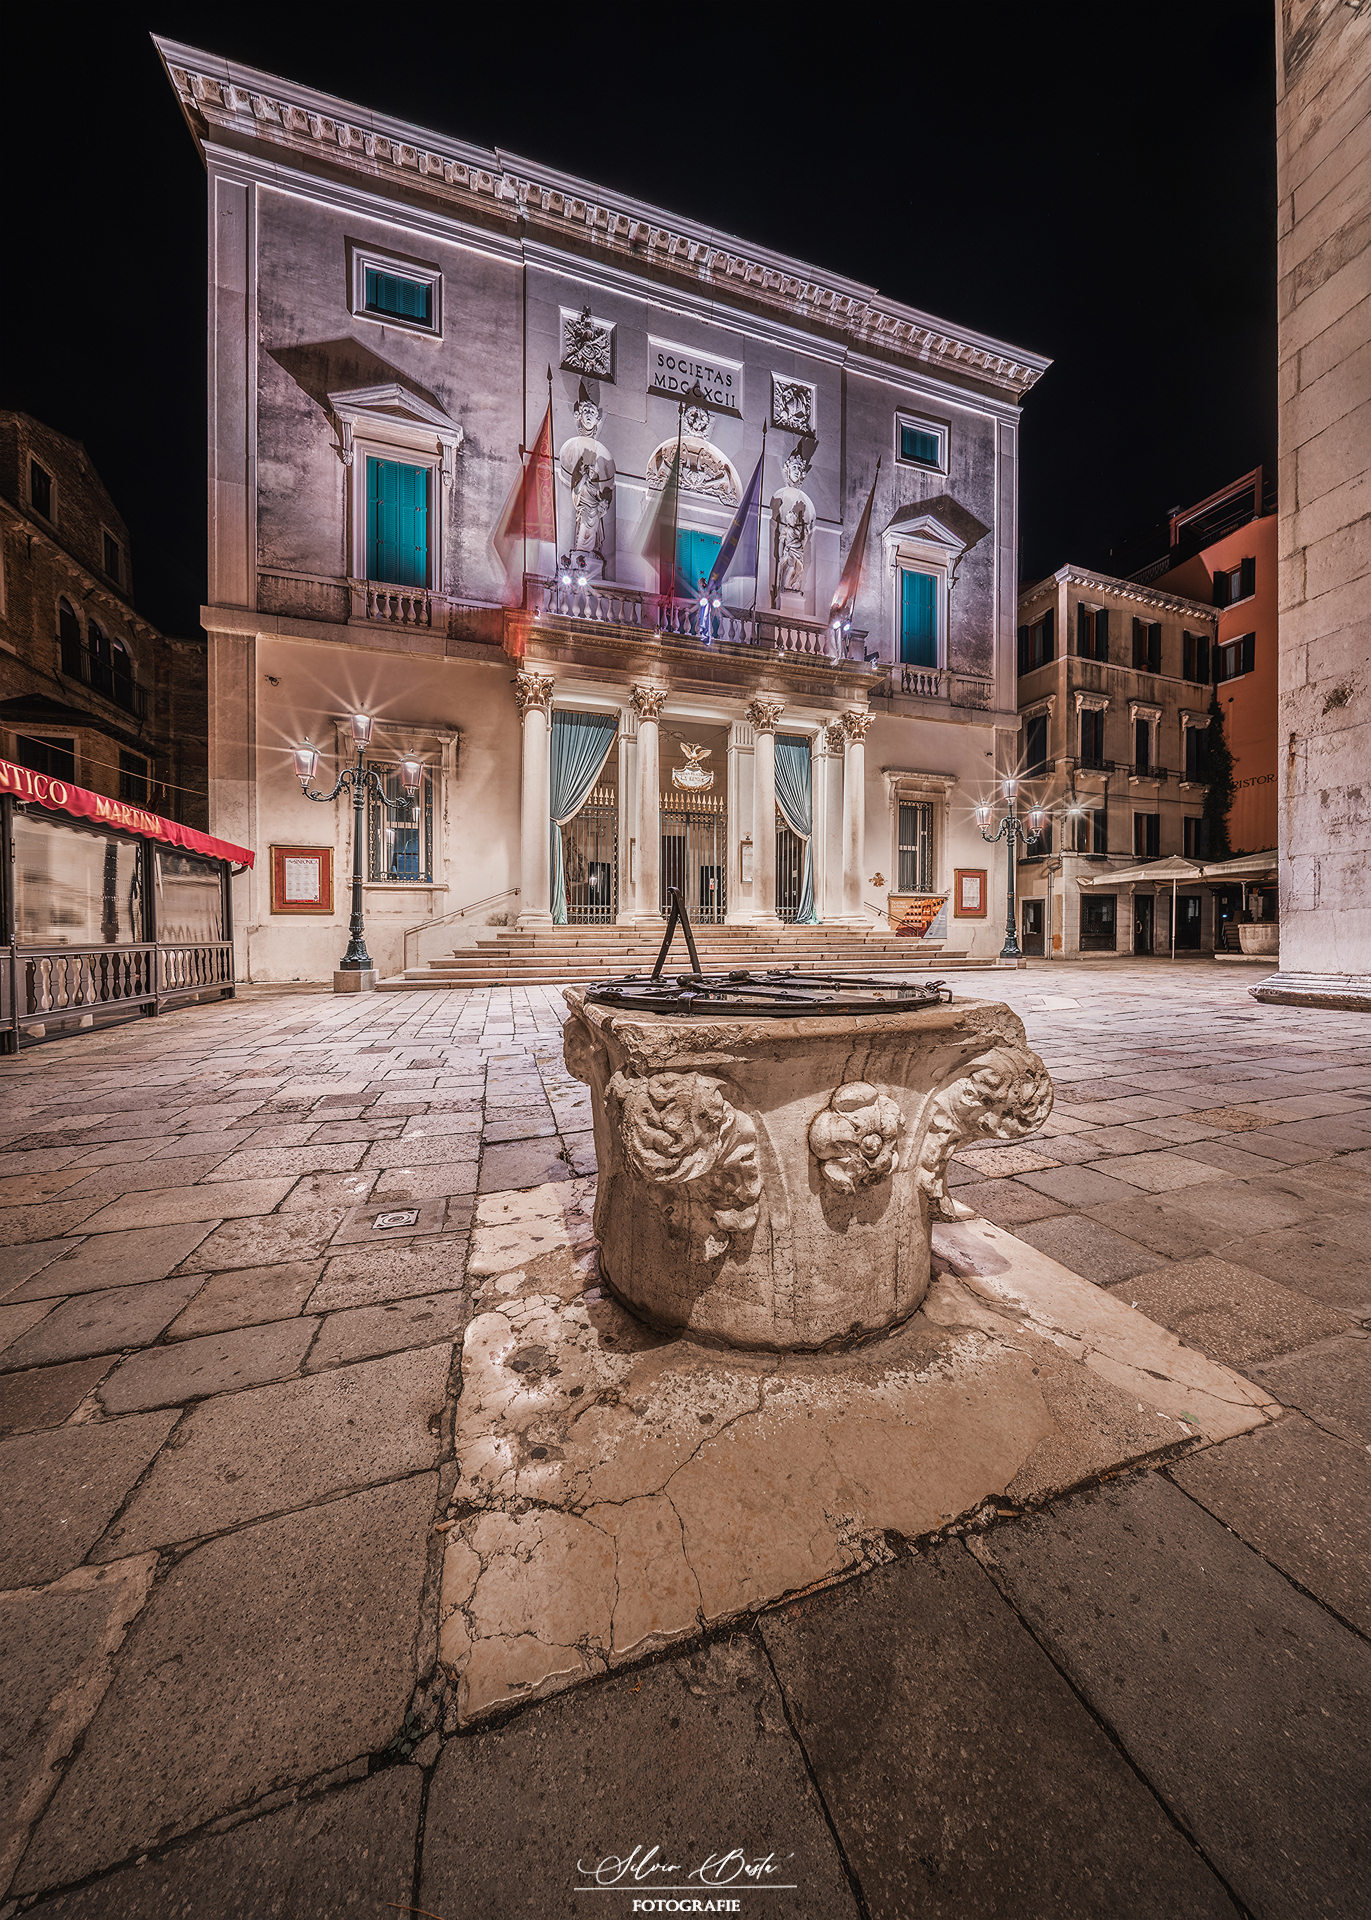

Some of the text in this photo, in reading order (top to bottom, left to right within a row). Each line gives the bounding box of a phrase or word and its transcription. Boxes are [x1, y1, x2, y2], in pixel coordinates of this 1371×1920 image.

[657, 353, 732, 387] SOCIETAS
[654, 373, 735, 407] MDCCXCII
[95, 796, 162, 834] MARTINI
